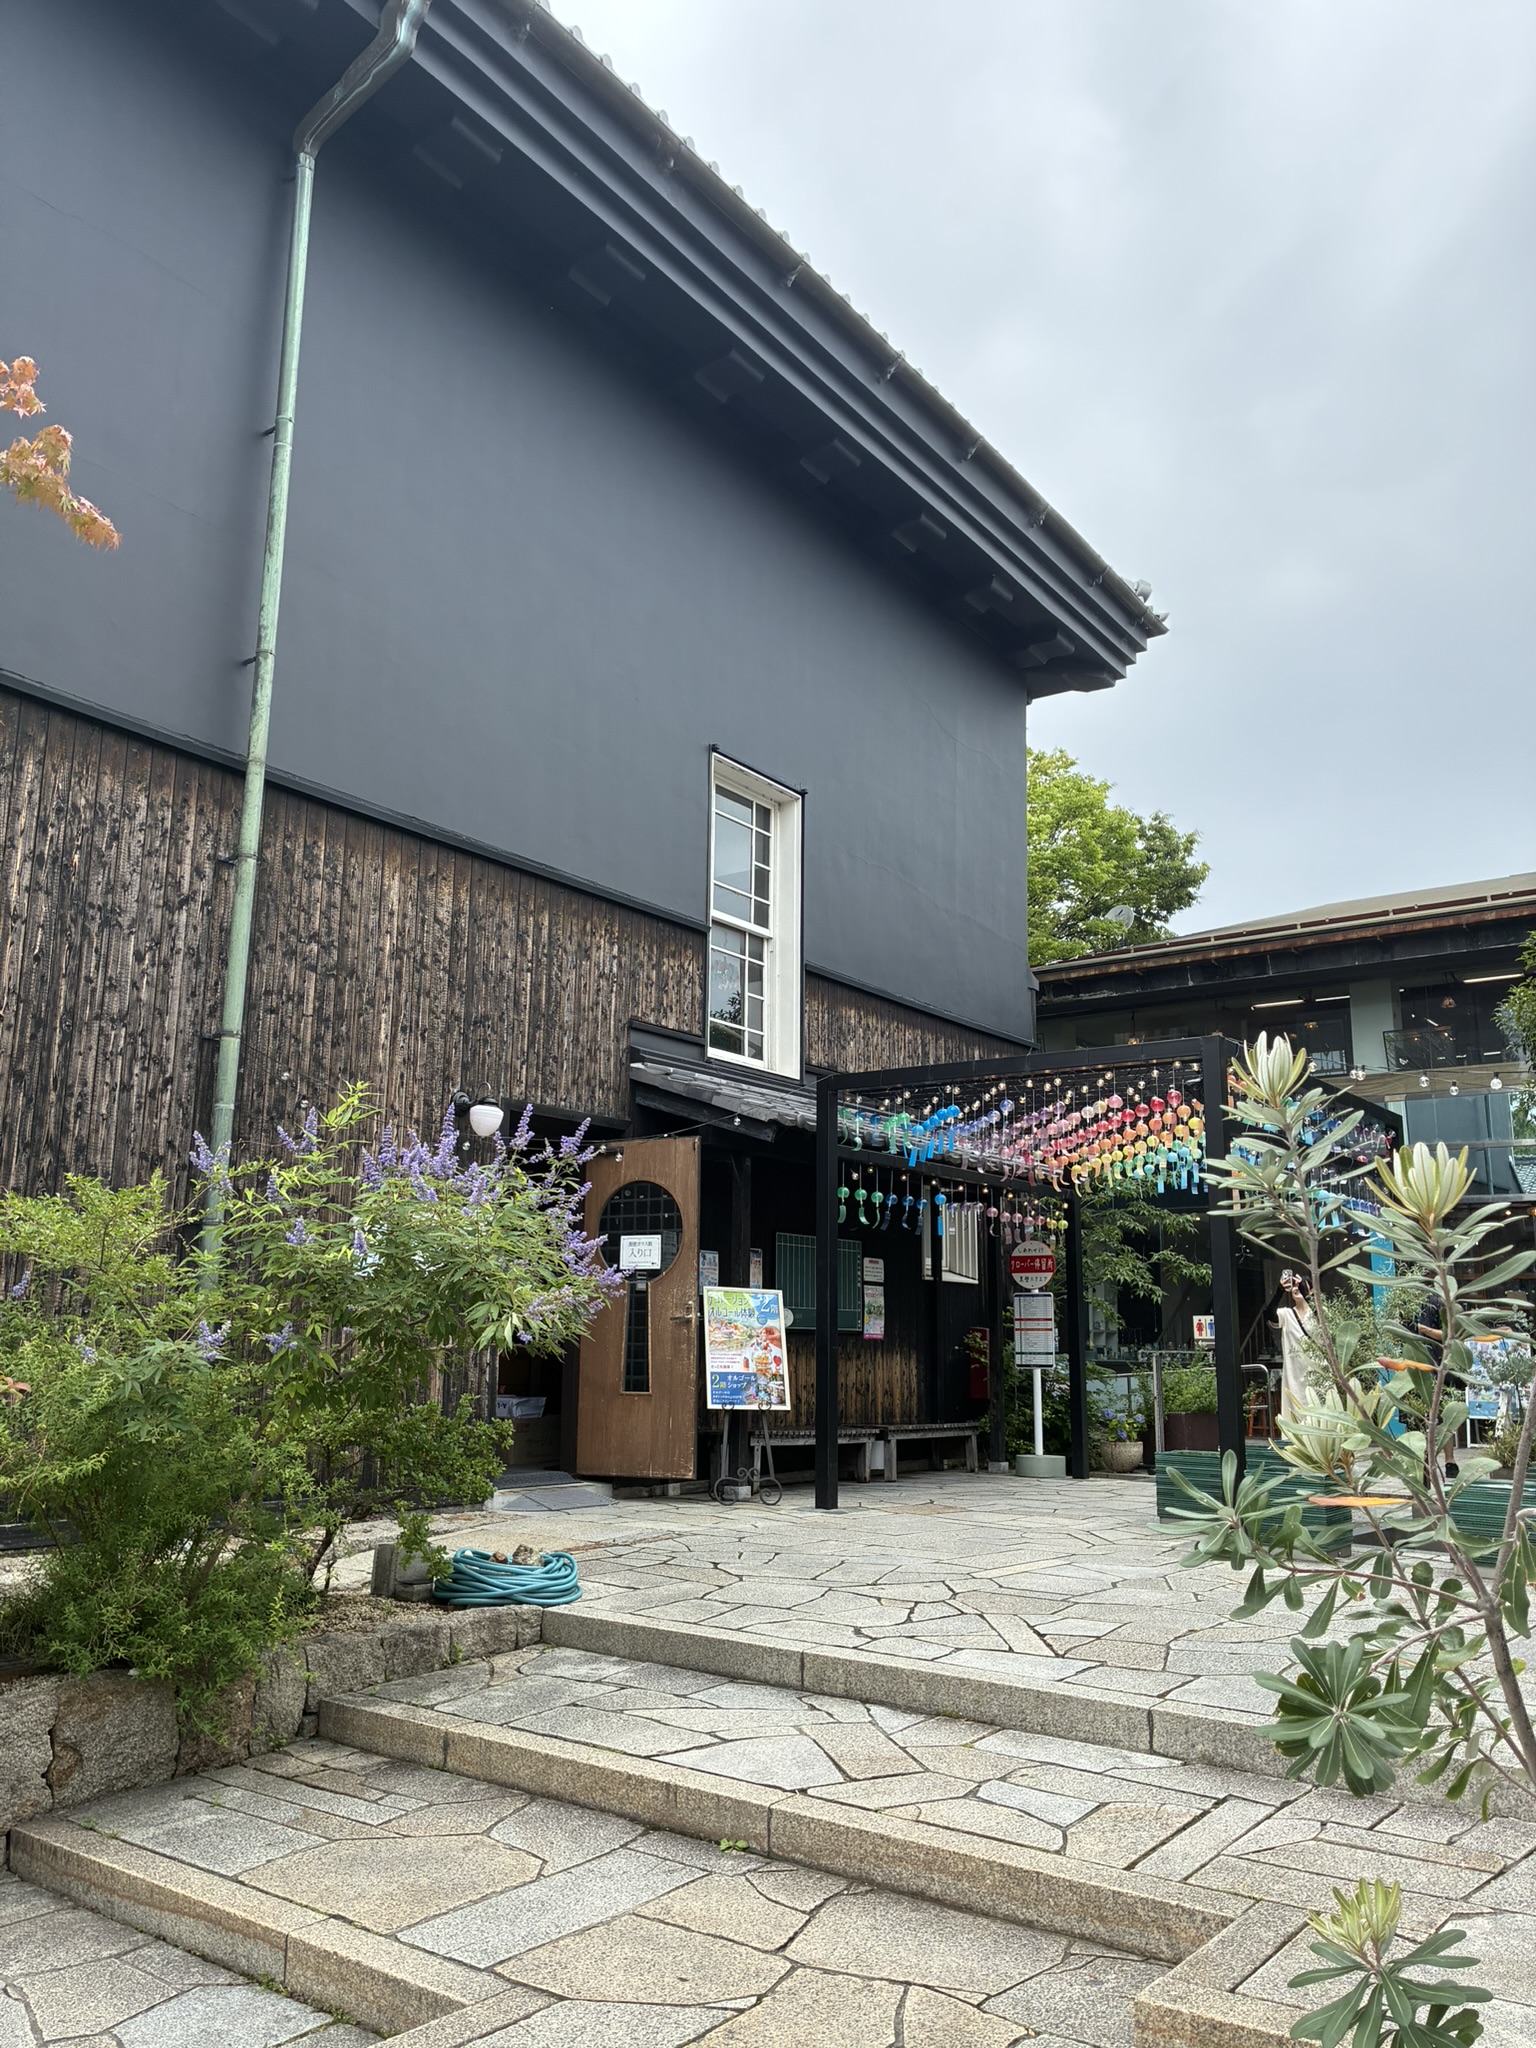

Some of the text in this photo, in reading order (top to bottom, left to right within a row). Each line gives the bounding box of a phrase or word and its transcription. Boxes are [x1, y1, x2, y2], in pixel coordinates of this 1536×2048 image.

[628, 1248, 652, 1258] 入り口
[727, 1381, 747, 1389] ショップ
